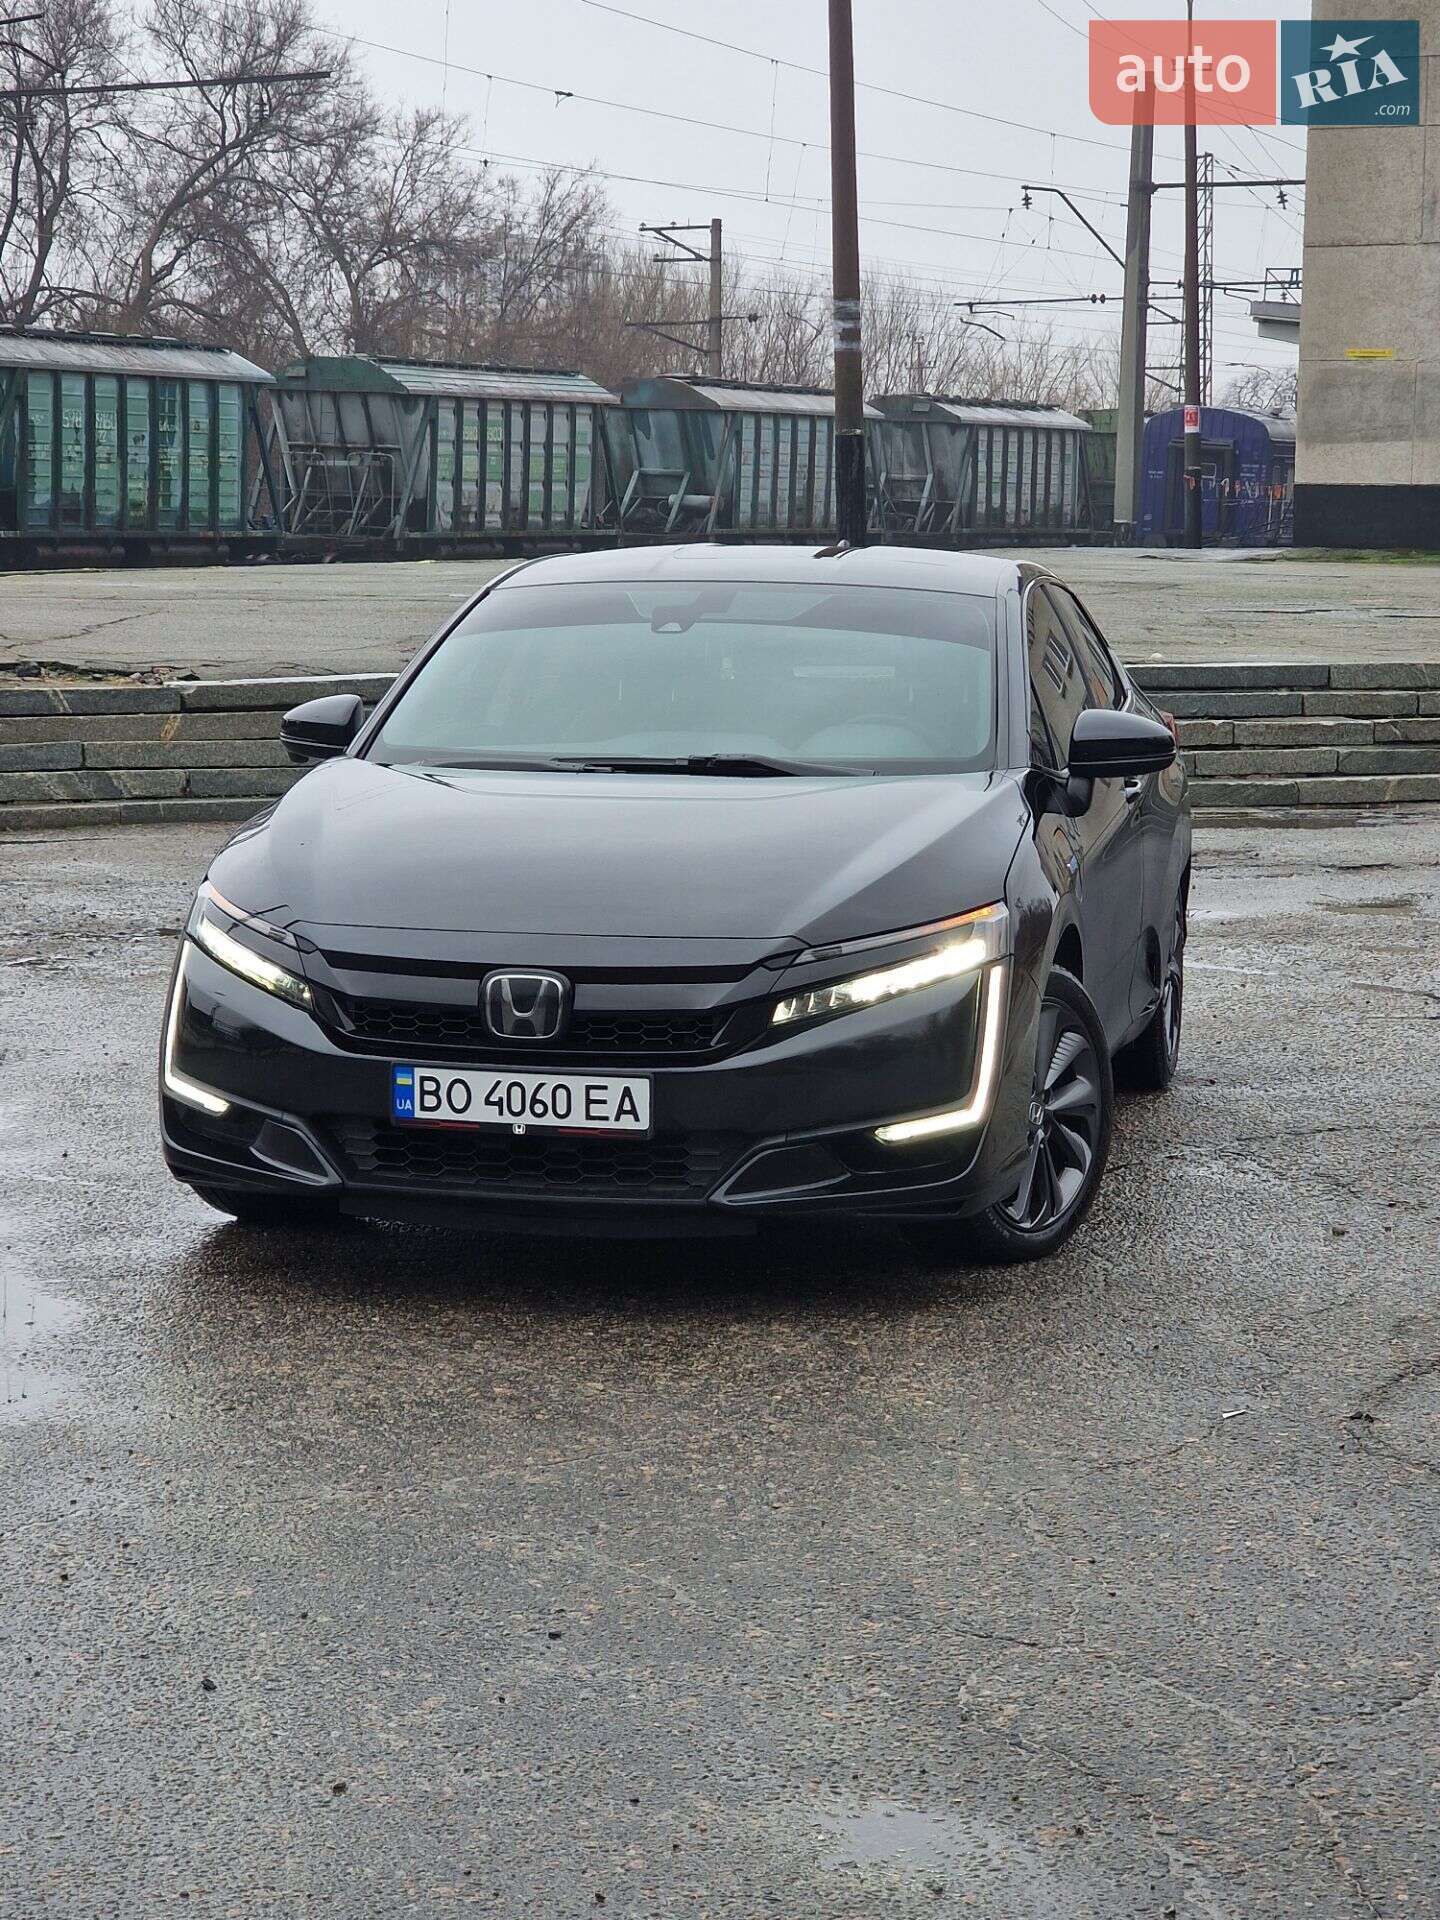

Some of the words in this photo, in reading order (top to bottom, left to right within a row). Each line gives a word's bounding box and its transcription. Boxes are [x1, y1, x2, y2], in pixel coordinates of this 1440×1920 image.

[396, 1099, 413, 1111] UA
[419, 1075, 472, 1114] BO
[484, 1080, 572, 1119] 4060
[585, 1084, 641, 1122] EA
